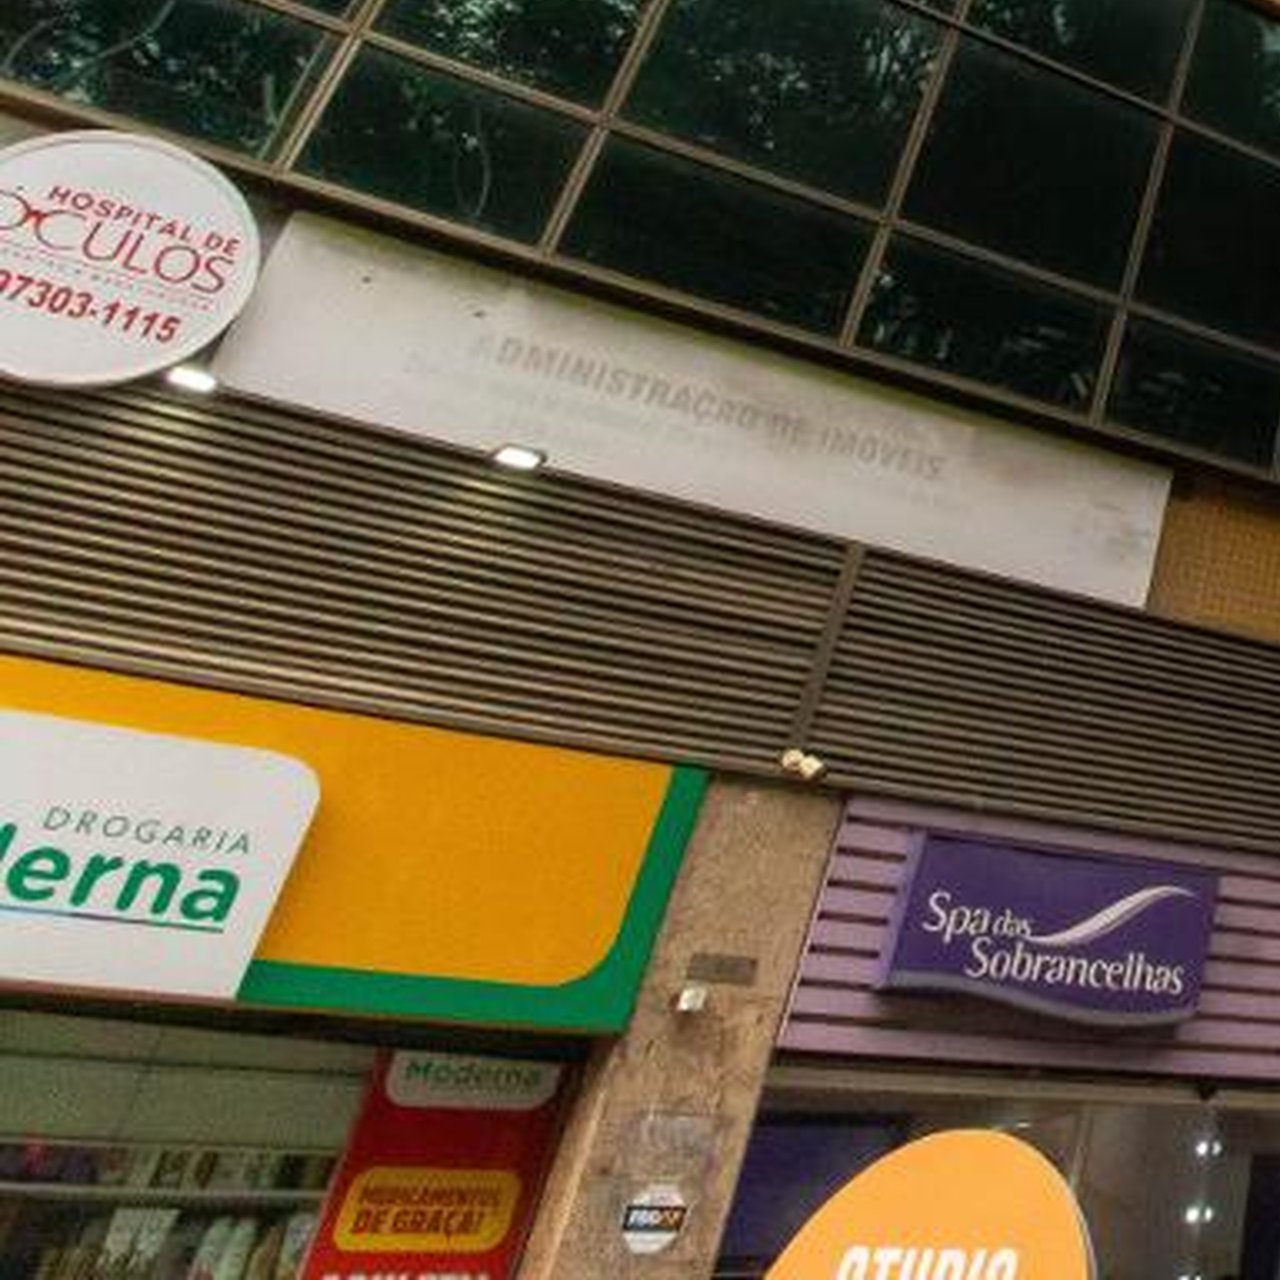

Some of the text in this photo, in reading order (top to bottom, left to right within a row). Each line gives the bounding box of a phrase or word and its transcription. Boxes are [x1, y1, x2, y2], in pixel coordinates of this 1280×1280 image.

[48, 186, 241, 256] HOSPITAL DE
[43, 806, 251, 854] DROGARIA
[922, 891, 1032, 944] Spa das
[966, 937, 1185, 995] Sobrancelhas
